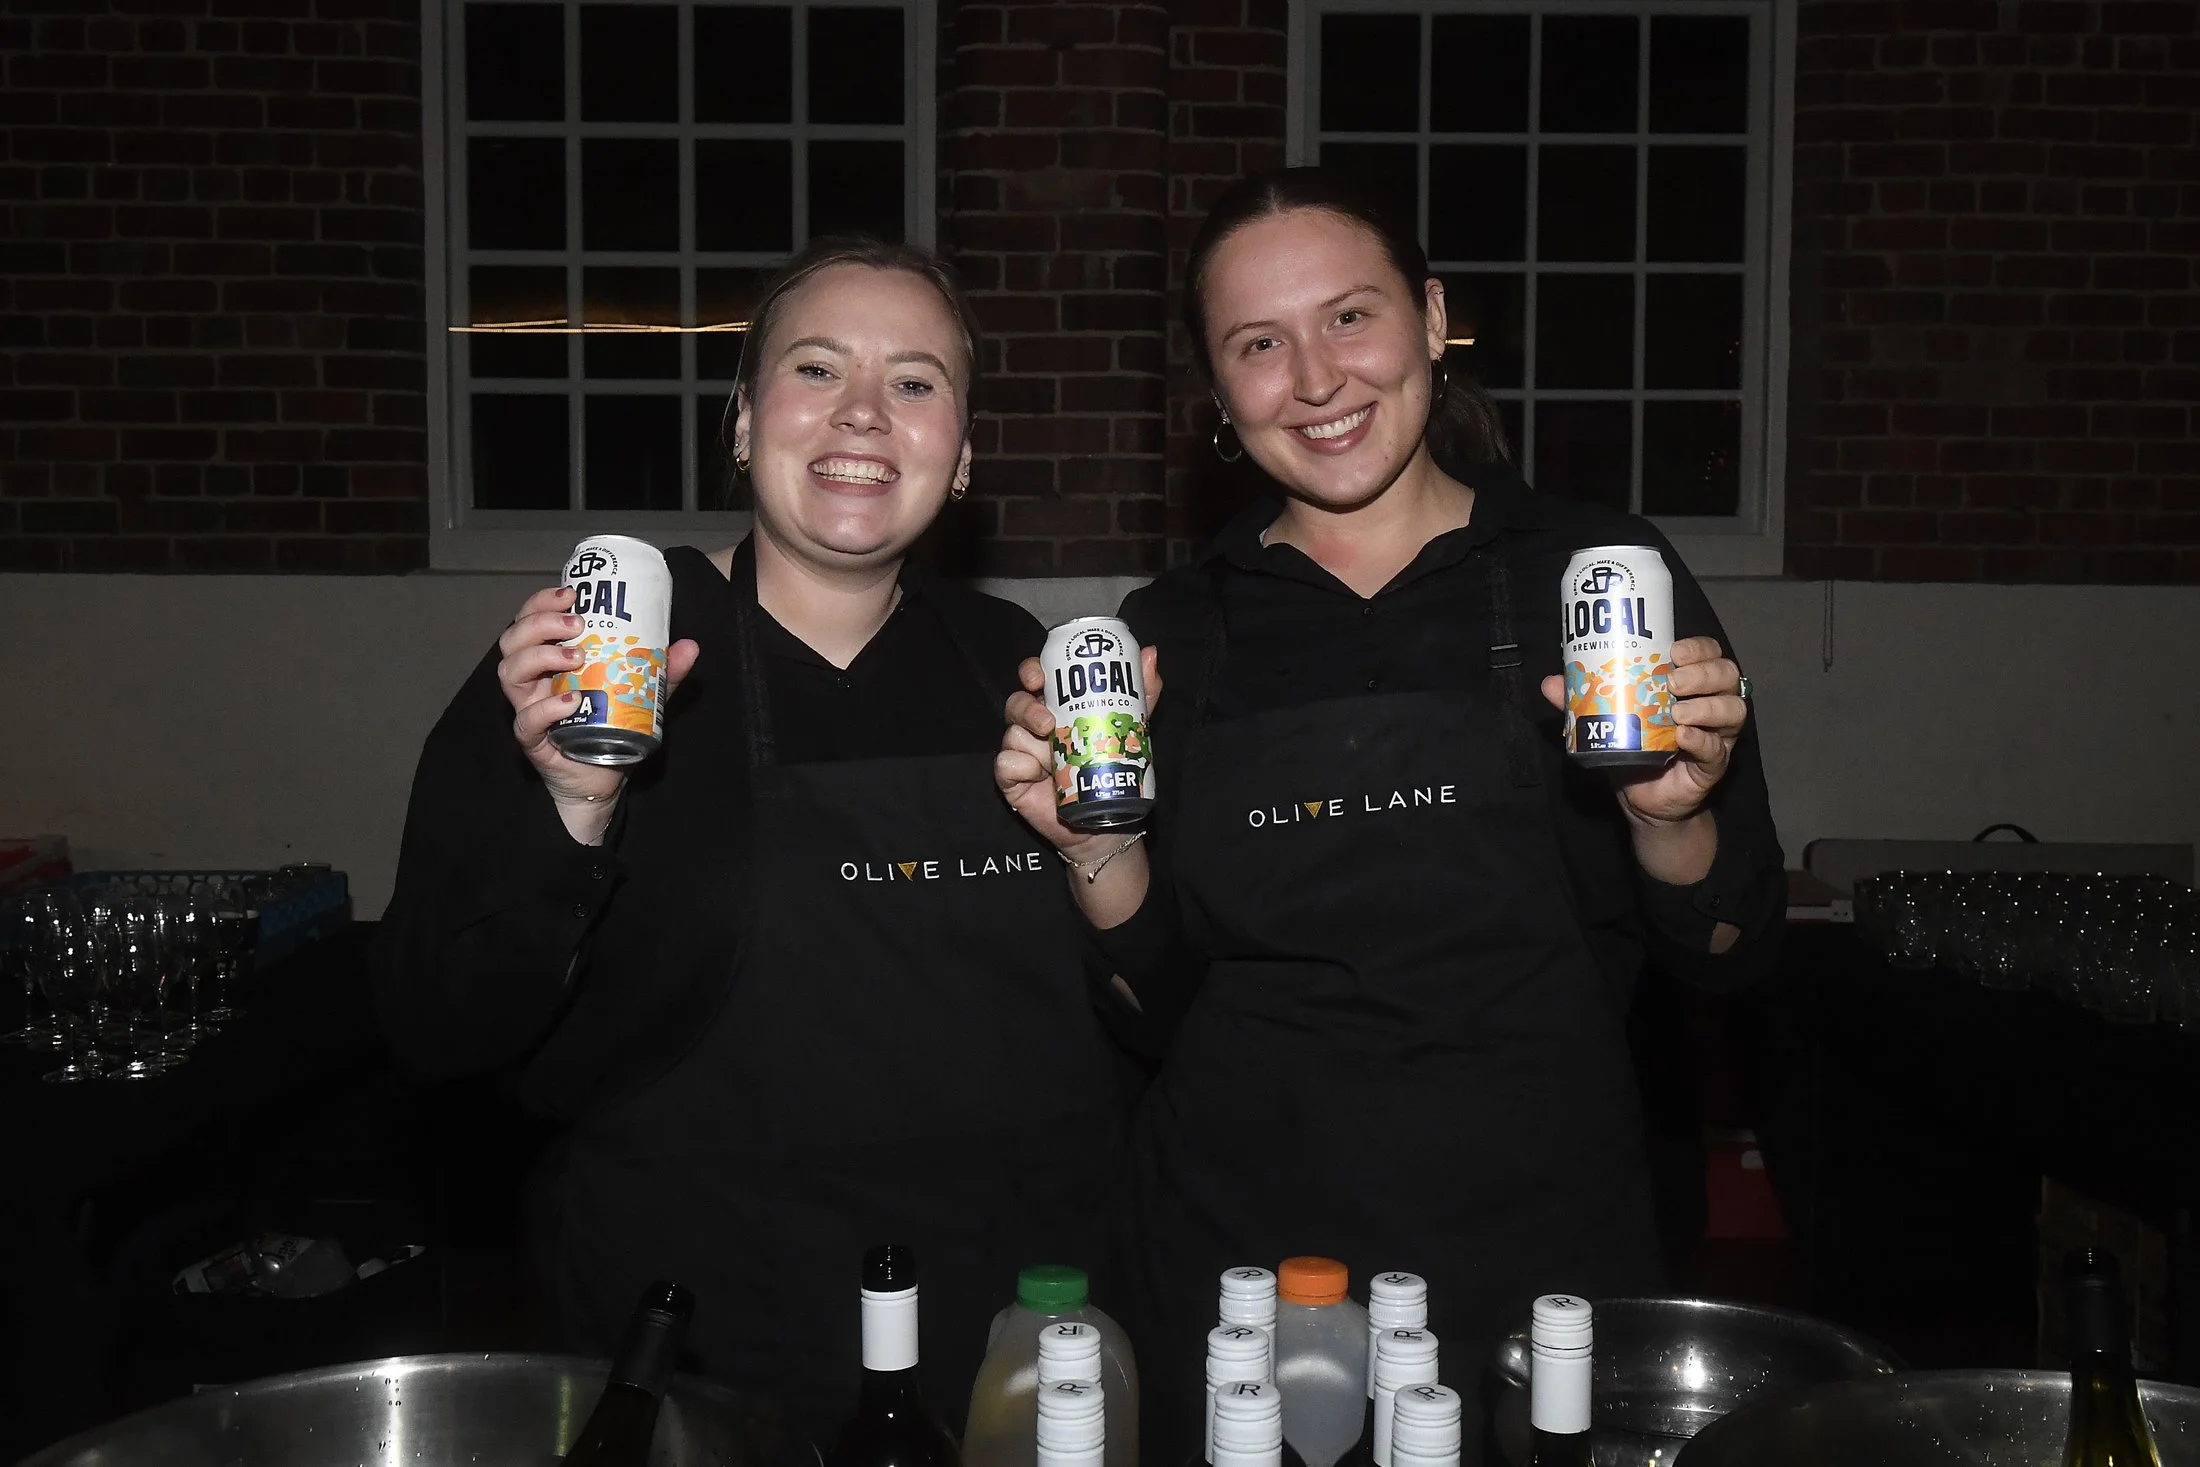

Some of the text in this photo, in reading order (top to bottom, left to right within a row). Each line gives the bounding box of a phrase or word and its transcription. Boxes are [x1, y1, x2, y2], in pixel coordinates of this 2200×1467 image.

[562, 580, 632, 622] CAL
[598, 620, 618, 629] CO.
[1565, 597, 1653, 645] LOCAL
[1055, 661, 1139, 707] LOCAL
[1069, 698, 1133, 712] BREWING CO.
[1080, 771, 1137, 791] LAGER
[1249, 785, 1456, 827] OLIVE LANE
[840, 852, 1042, 881] OLIVE LANE
[1235, 1269, 1263, 1279] R
[1384, 1273, 1409, 1284] R
[1551, 1297, 1579, 1307] R
[1057, 1325, 1078, 1336] R
[1225, 1327, 1253, 1339] R
[1393, 1330, 1423, 1339] R
[1056, 1382, 1091, 1394] R
[1238, 1383, 1261, 1396] R
[1414, 1386, 1448, 1400] R
